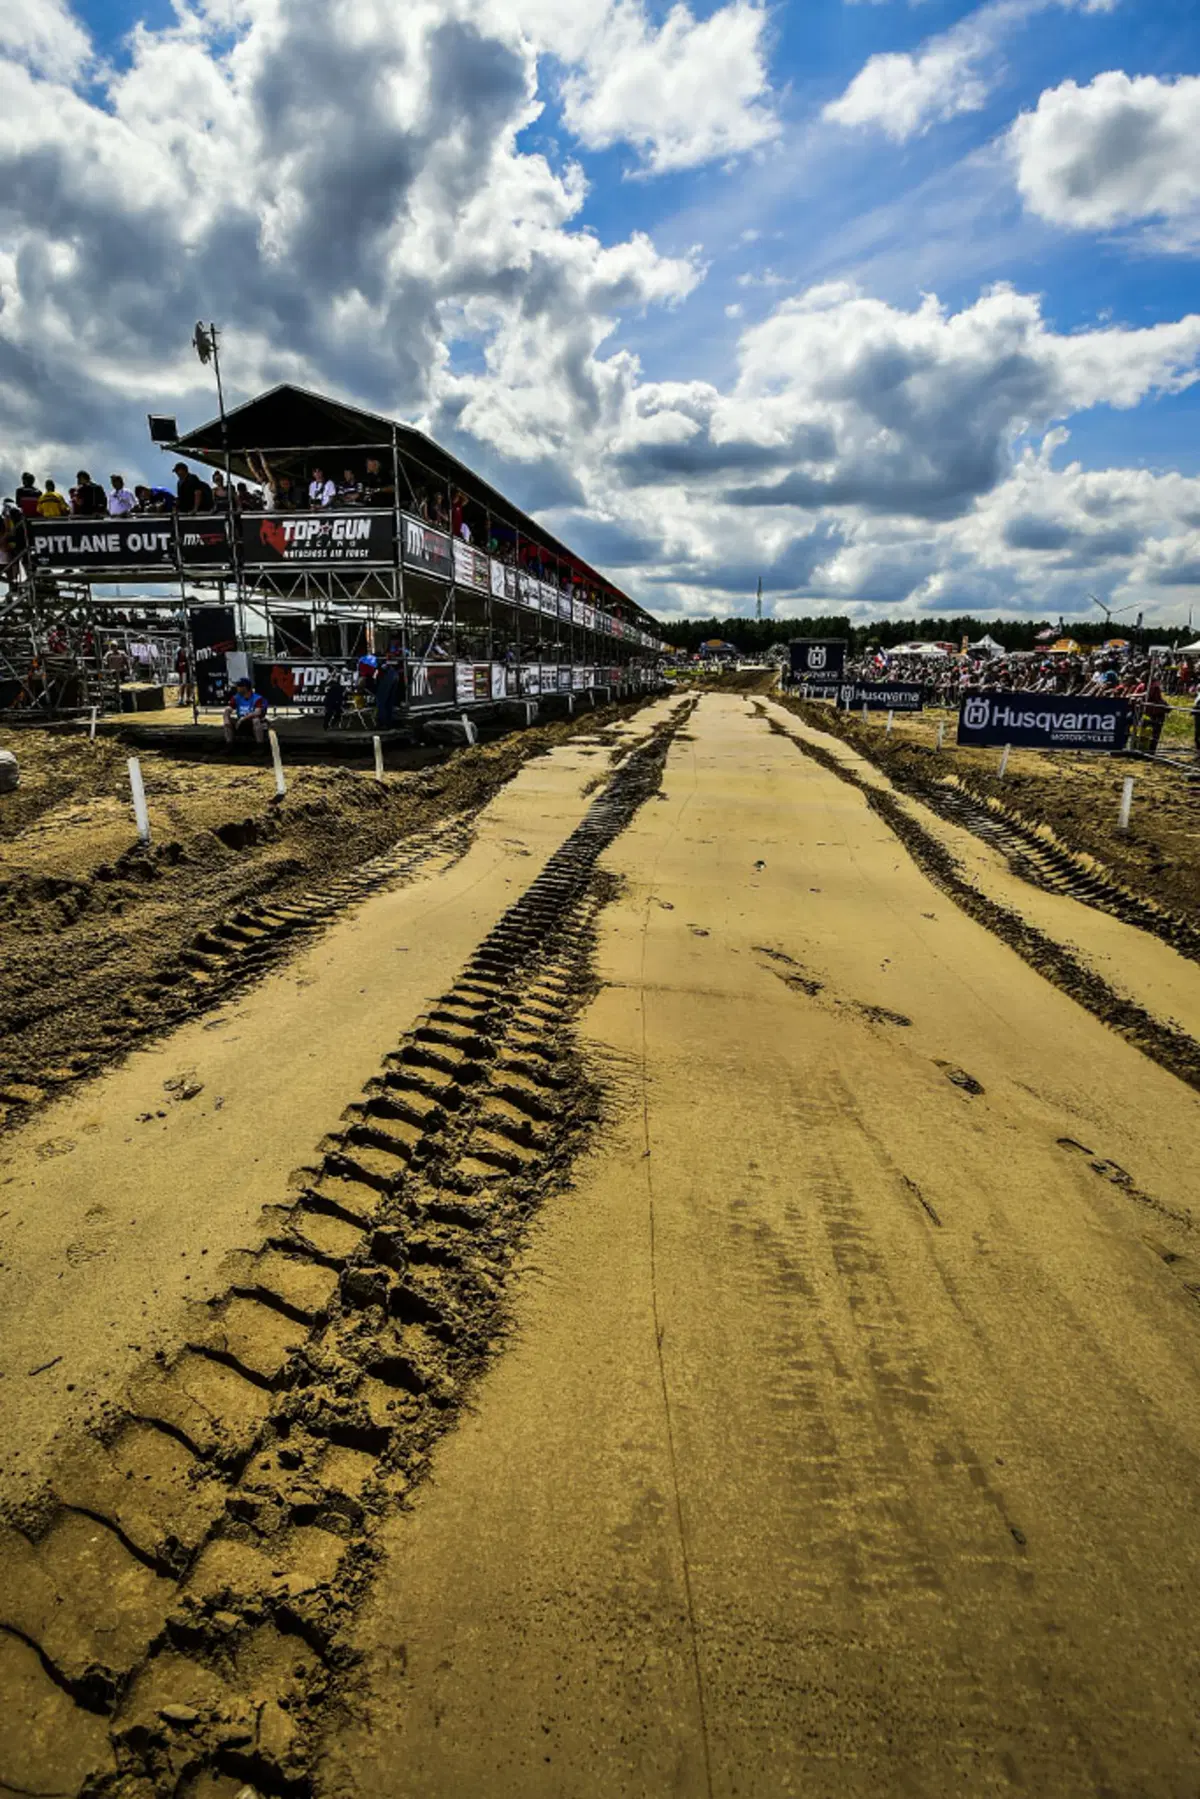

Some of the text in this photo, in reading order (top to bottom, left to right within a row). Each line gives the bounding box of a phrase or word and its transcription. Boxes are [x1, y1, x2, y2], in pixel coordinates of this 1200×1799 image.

[282, 518, 371, 541] TOP GUN
[34, 532, 171, 553] PITLANE OUT
[291, 667, 328, 686] TOP
[855, 687, 919, 703] Husqvarna
[991, 705, 1116, 731] Husqvarna
[1050, 733, 1115, 742] MOTORCYCLES
